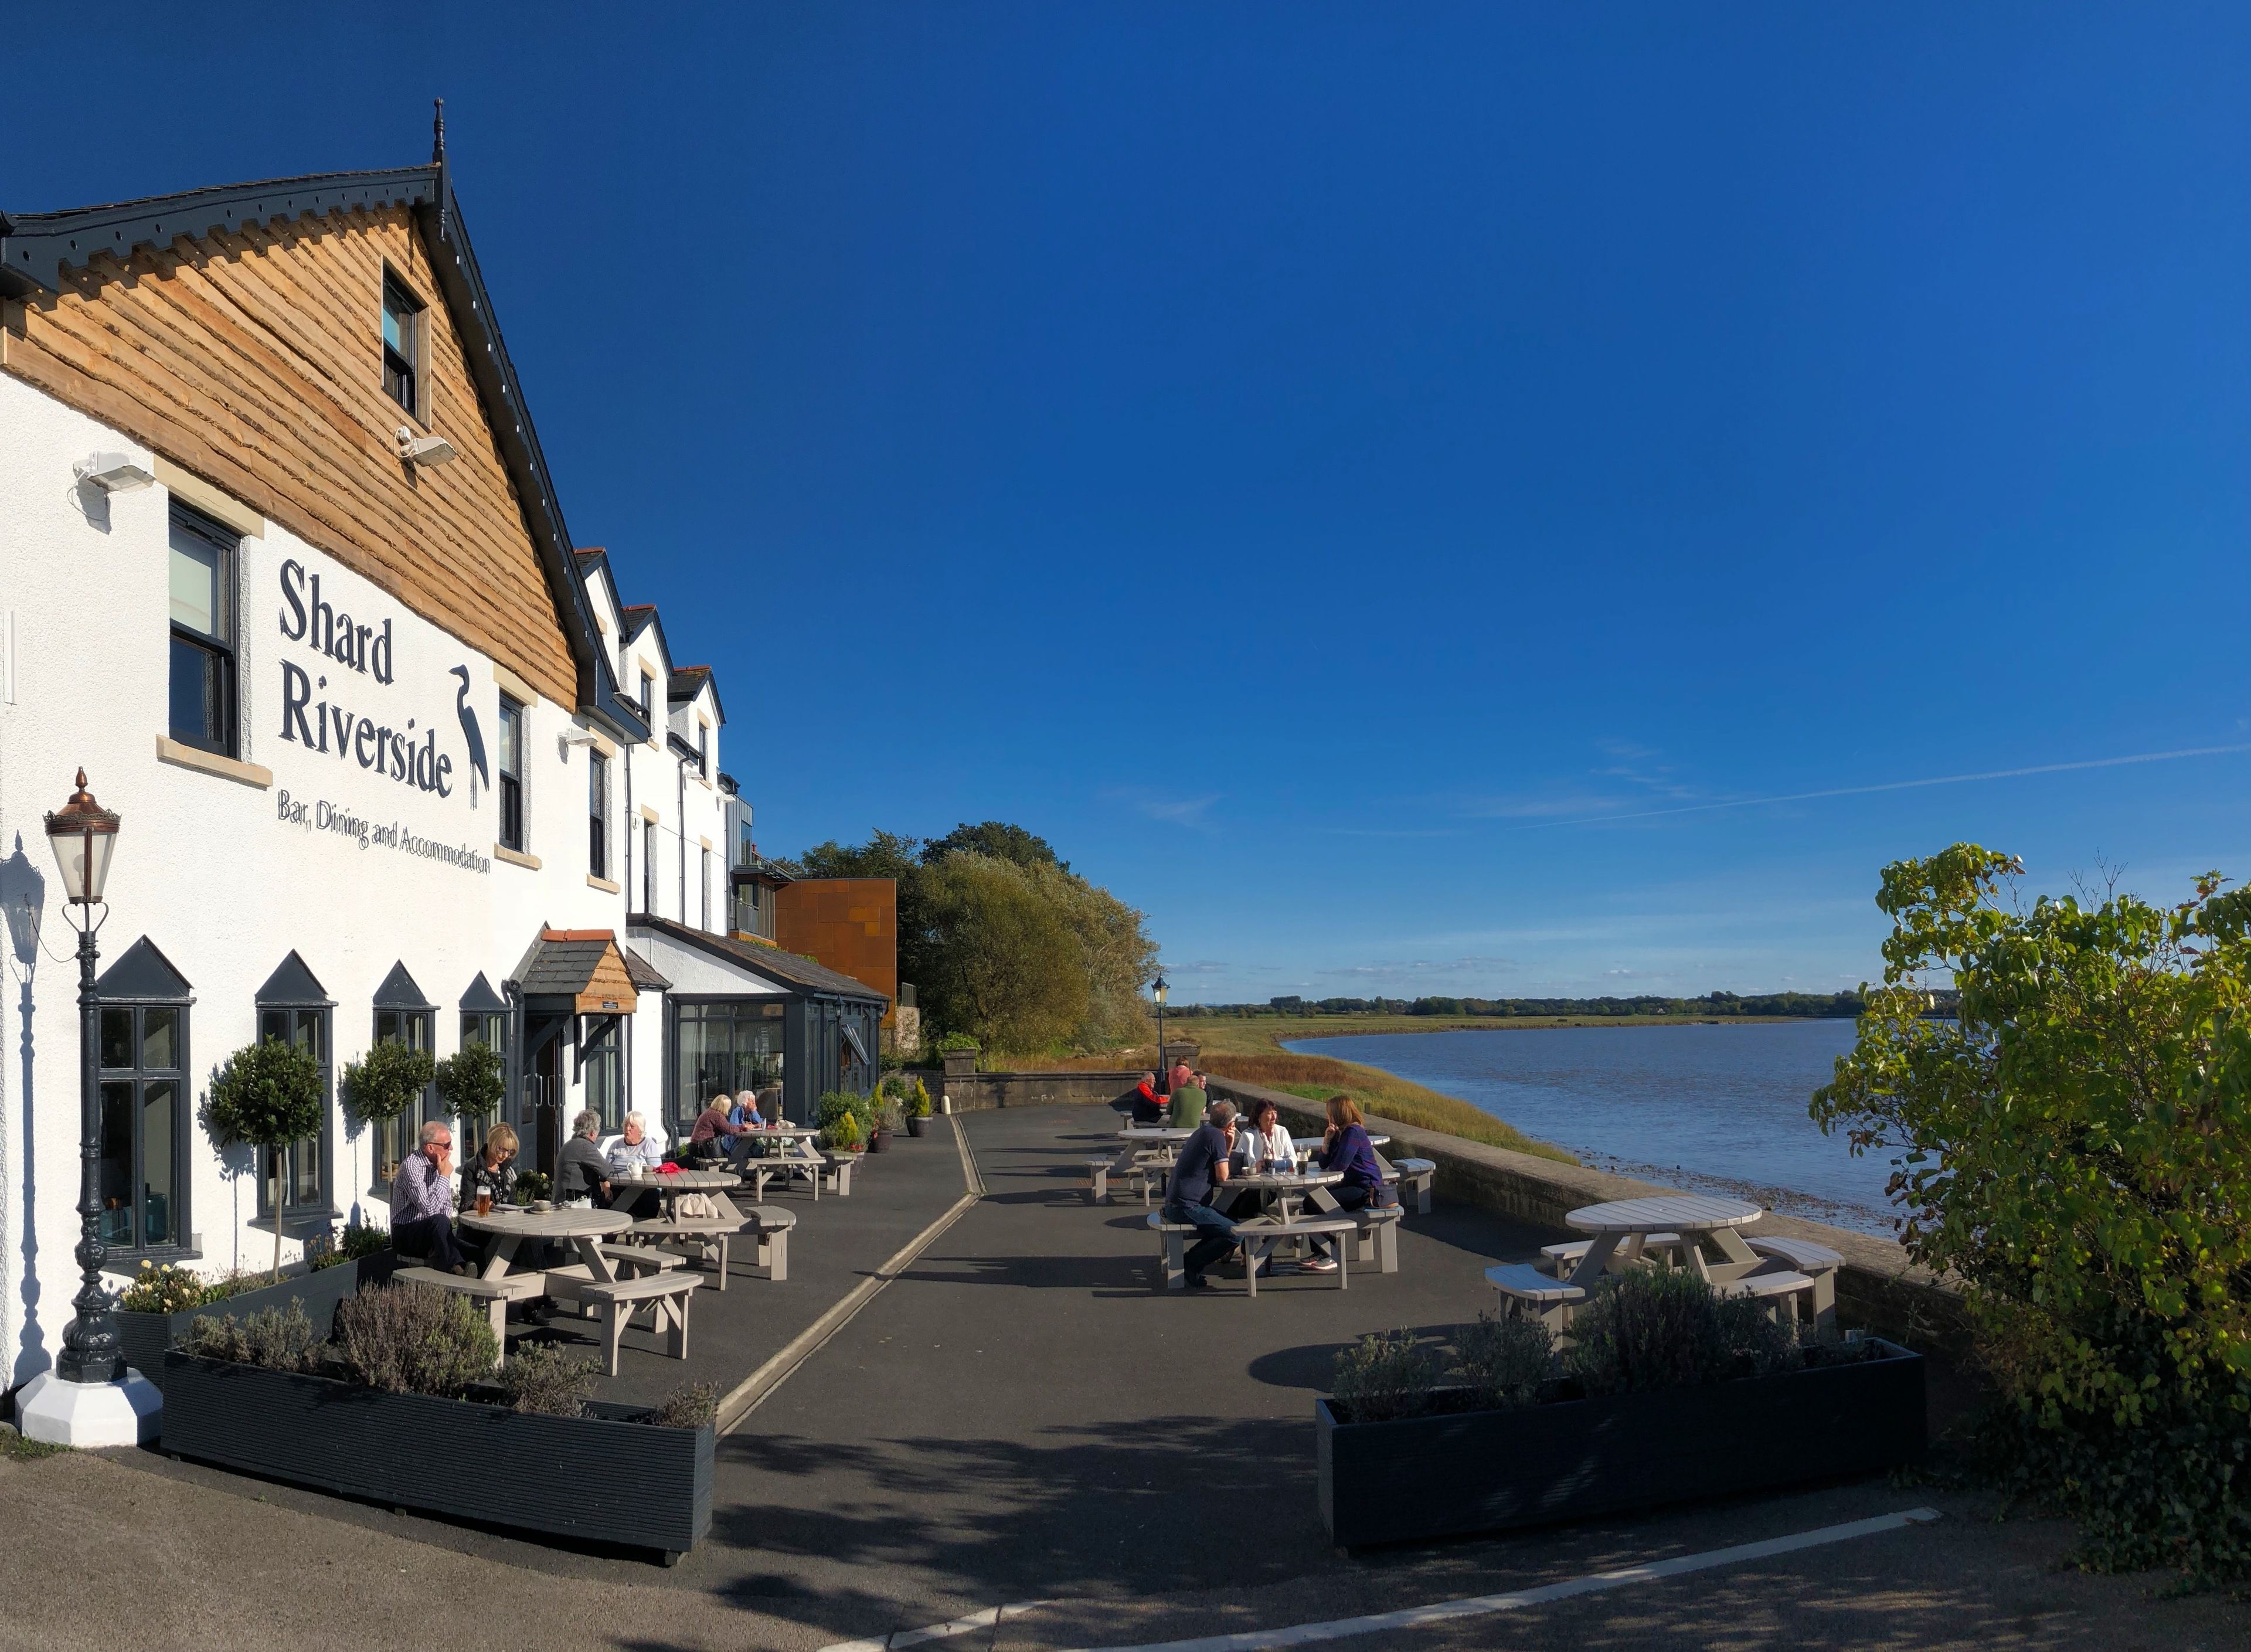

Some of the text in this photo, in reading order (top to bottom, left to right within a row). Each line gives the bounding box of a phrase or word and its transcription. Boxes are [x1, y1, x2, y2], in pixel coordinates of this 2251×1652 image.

[280, 559, 392, 685] Shard
[278, 658, 453, 798] Riverside
[278, 789, 490, 875] Bar, Dining and Accommodation
